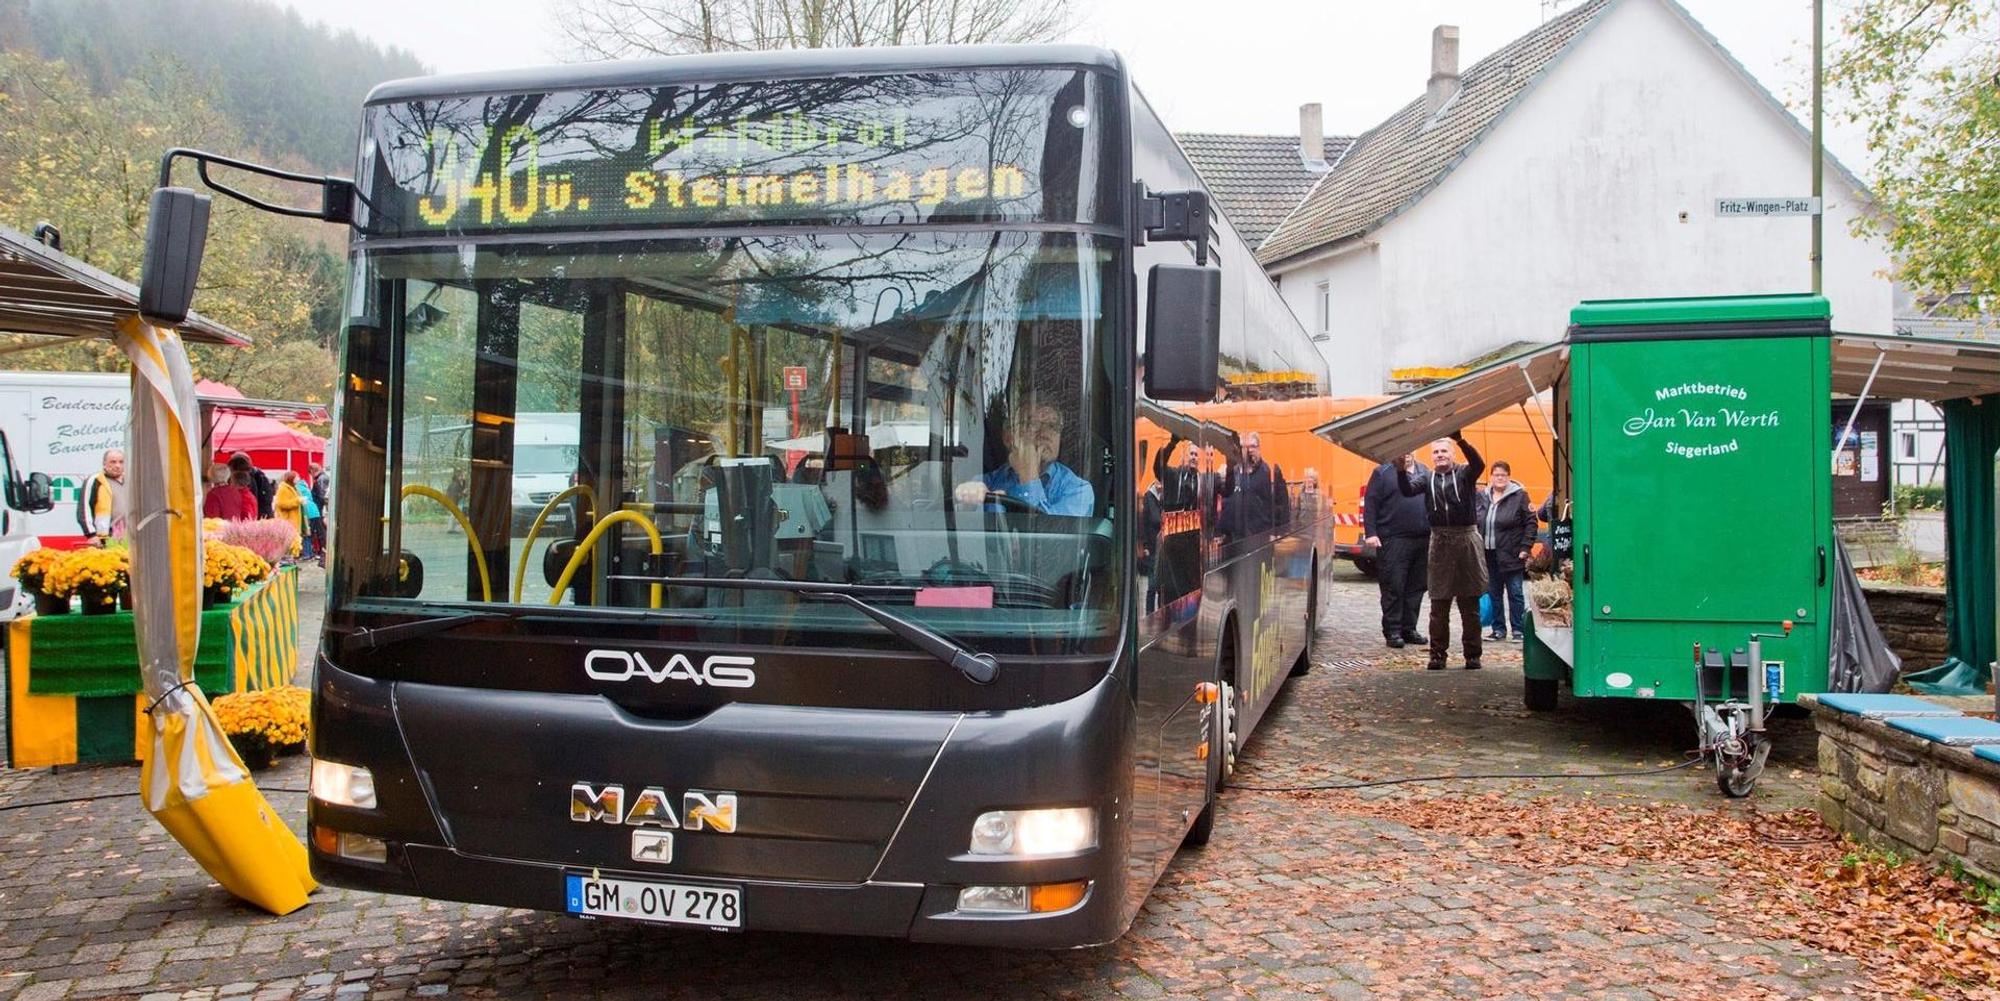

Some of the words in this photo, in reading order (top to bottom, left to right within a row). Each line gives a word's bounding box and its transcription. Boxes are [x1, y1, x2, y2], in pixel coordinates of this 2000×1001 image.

[419, 124, 538, 225] 340
[625, 163, 1026, 209] Steimelhagen
[1719, 200, 1809, 215] Fritz-Wingen-Platz
[1655, 382, 1747, 401] Marktbetrieb
[1623, 407, 1676, 436] Jan
[1677, 408, 1717, 428] Van
[1718, 408, 1780, 428] Werth
[1665, 439, 1739, 458] Siegerland
[570, 782, 738, 834] MAN
[585, 882, 619, 912] GM
[641, 887, 676, 917] OV
[685, 890, 738, 922] 278
